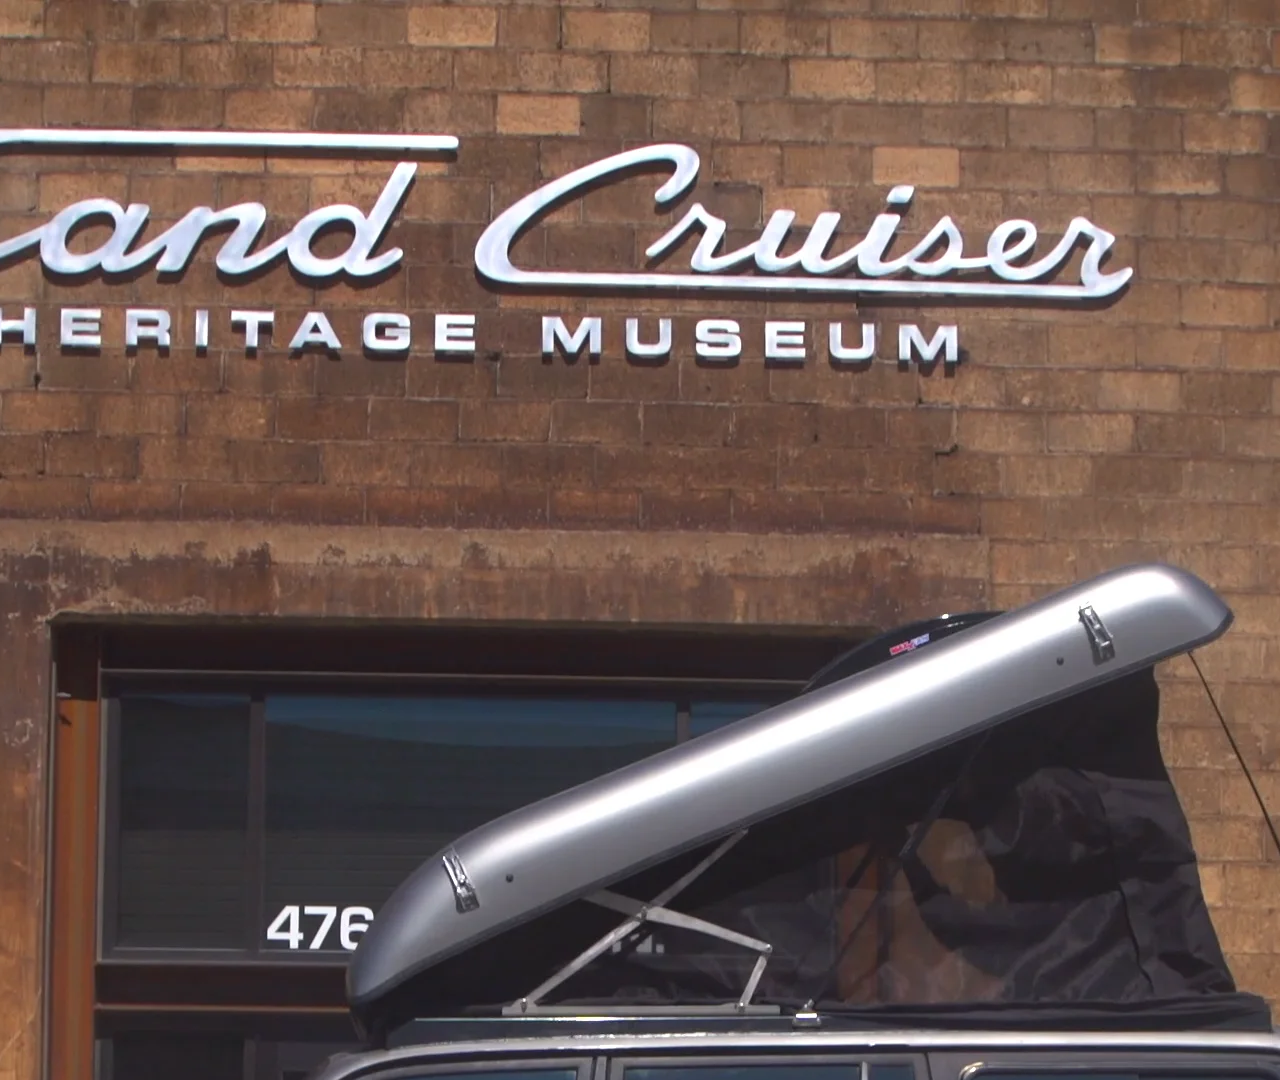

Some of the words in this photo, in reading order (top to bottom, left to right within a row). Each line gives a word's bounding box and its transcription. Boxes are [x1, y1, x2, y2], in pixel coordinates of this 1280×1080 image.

[474, 143, 1134, 298] Cruiser
[541, 316, 960, 362] MUSEUM
[266, 905, 375, 951] 476
